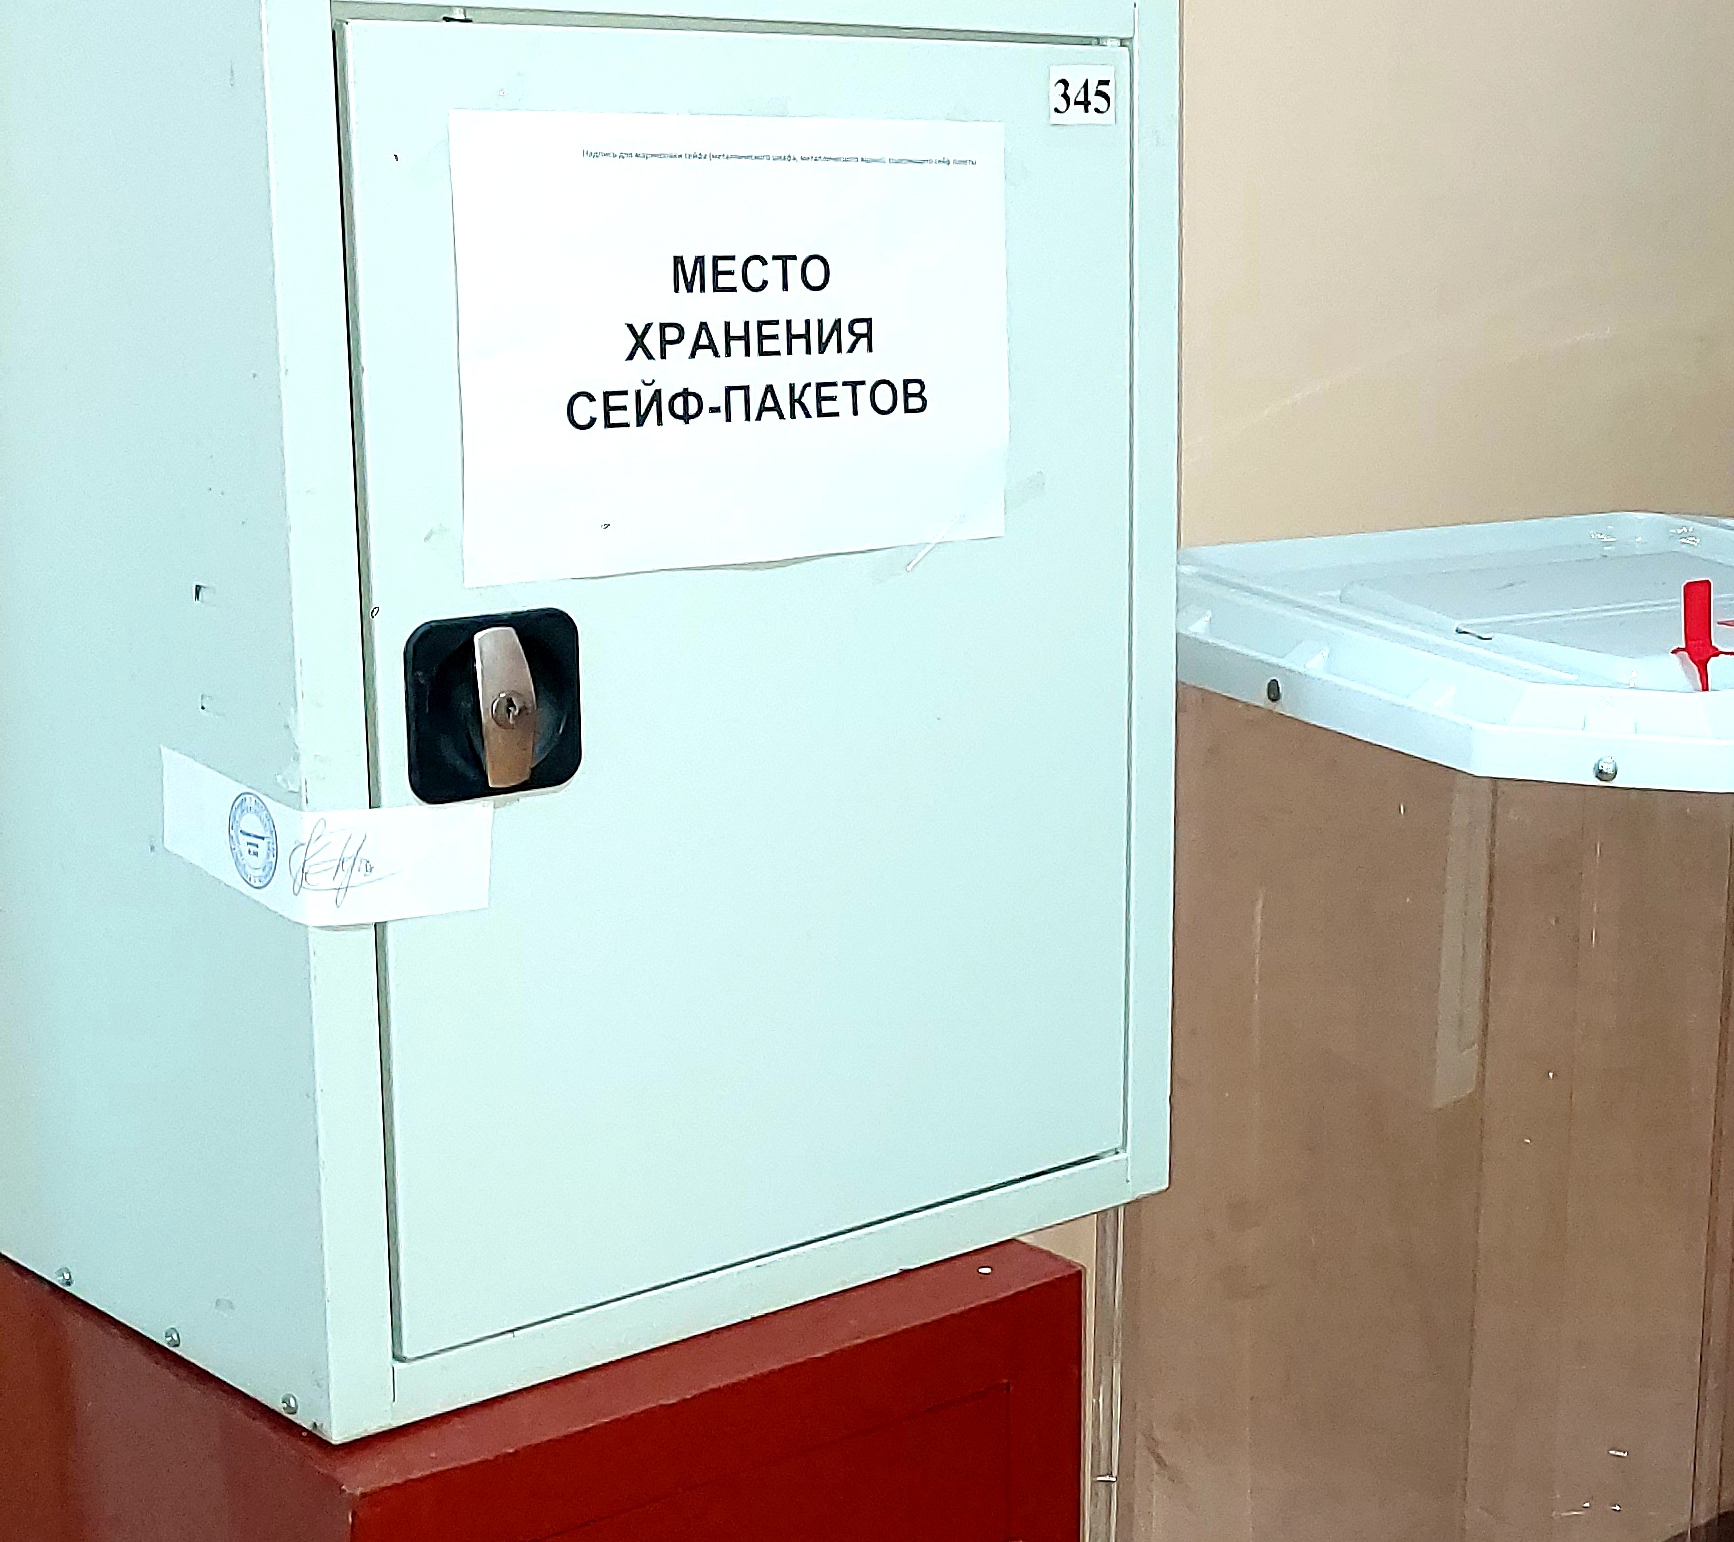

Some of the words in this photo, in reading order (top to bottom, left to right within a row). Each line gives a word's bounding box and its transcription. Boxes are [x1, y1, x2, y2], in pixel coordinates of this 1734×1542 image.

[1052, 77, 1112, 116] 345
[672, 253, 831, 294] МЕСТО
[624, 317, 875, 362] ХРАНЕНИЯ
[566, 377, 929, 431] СЕЙФ-ПАКЕТОВ
